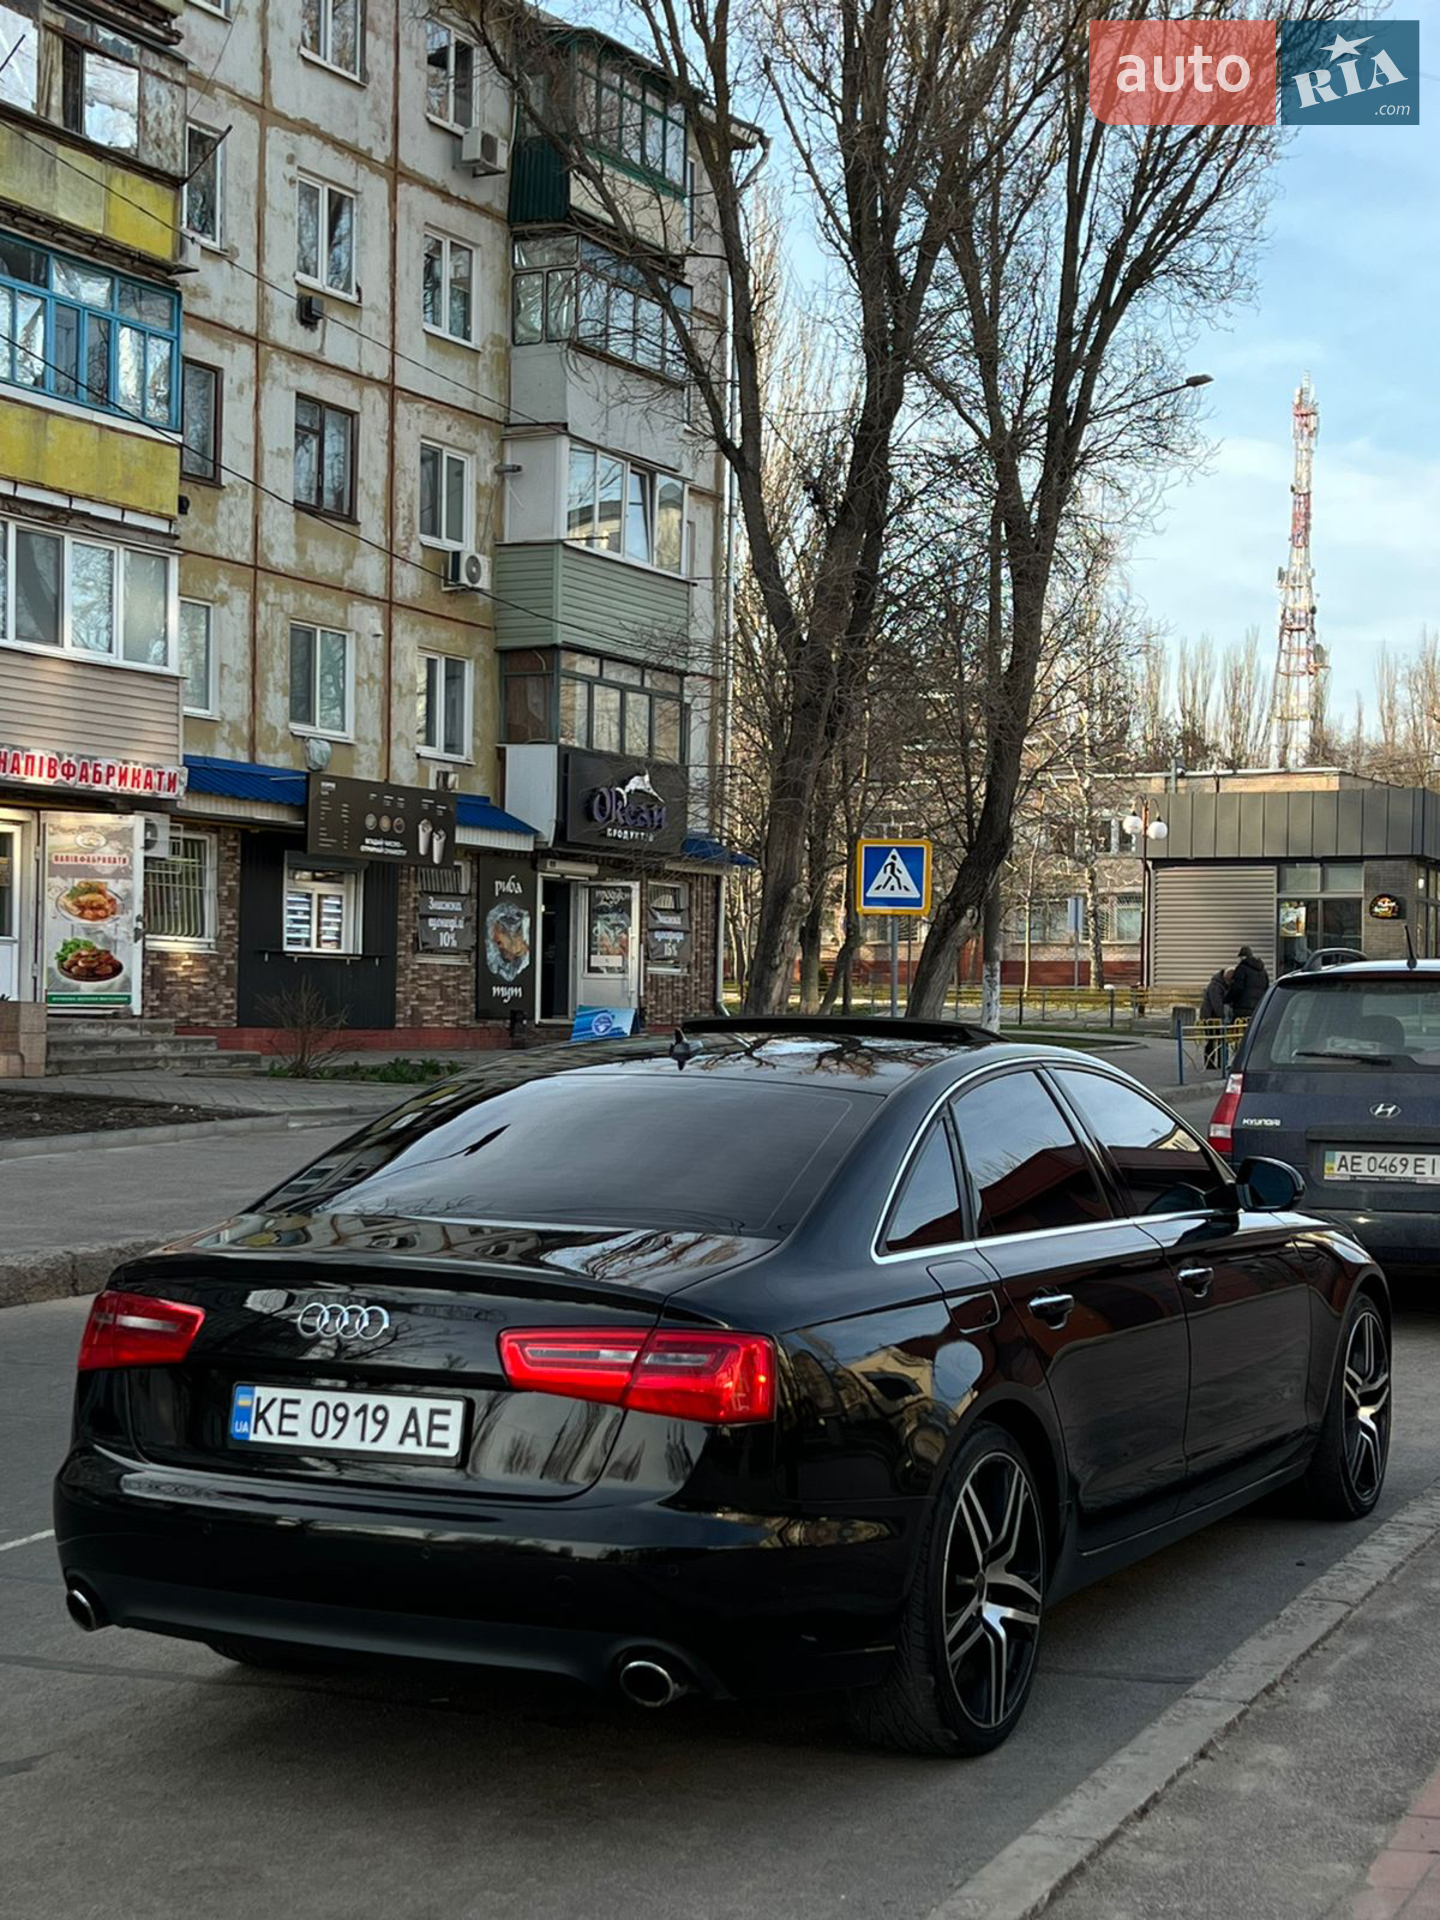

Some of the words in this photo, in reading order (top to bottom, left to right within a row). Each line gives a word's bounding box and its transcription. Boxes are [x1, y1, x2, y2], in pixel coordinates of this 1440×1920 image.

[494, 875, 522, 897] риба
[439, 931, 458, 947] 10%
[492, 986, 523, 1004] тут
[1242, 1118, 1282, 1127] HYUNDAI
[1337, 1155, 1364, 1173] AE
[1367, 1156, 1409, 1175] 0469
[234, 1421, 250, 1434] UA
[252, 1396, 301, 1437] KE
[311, 1401, 389, 1443] 0919
[398, 1407, 452, 1449] AE
